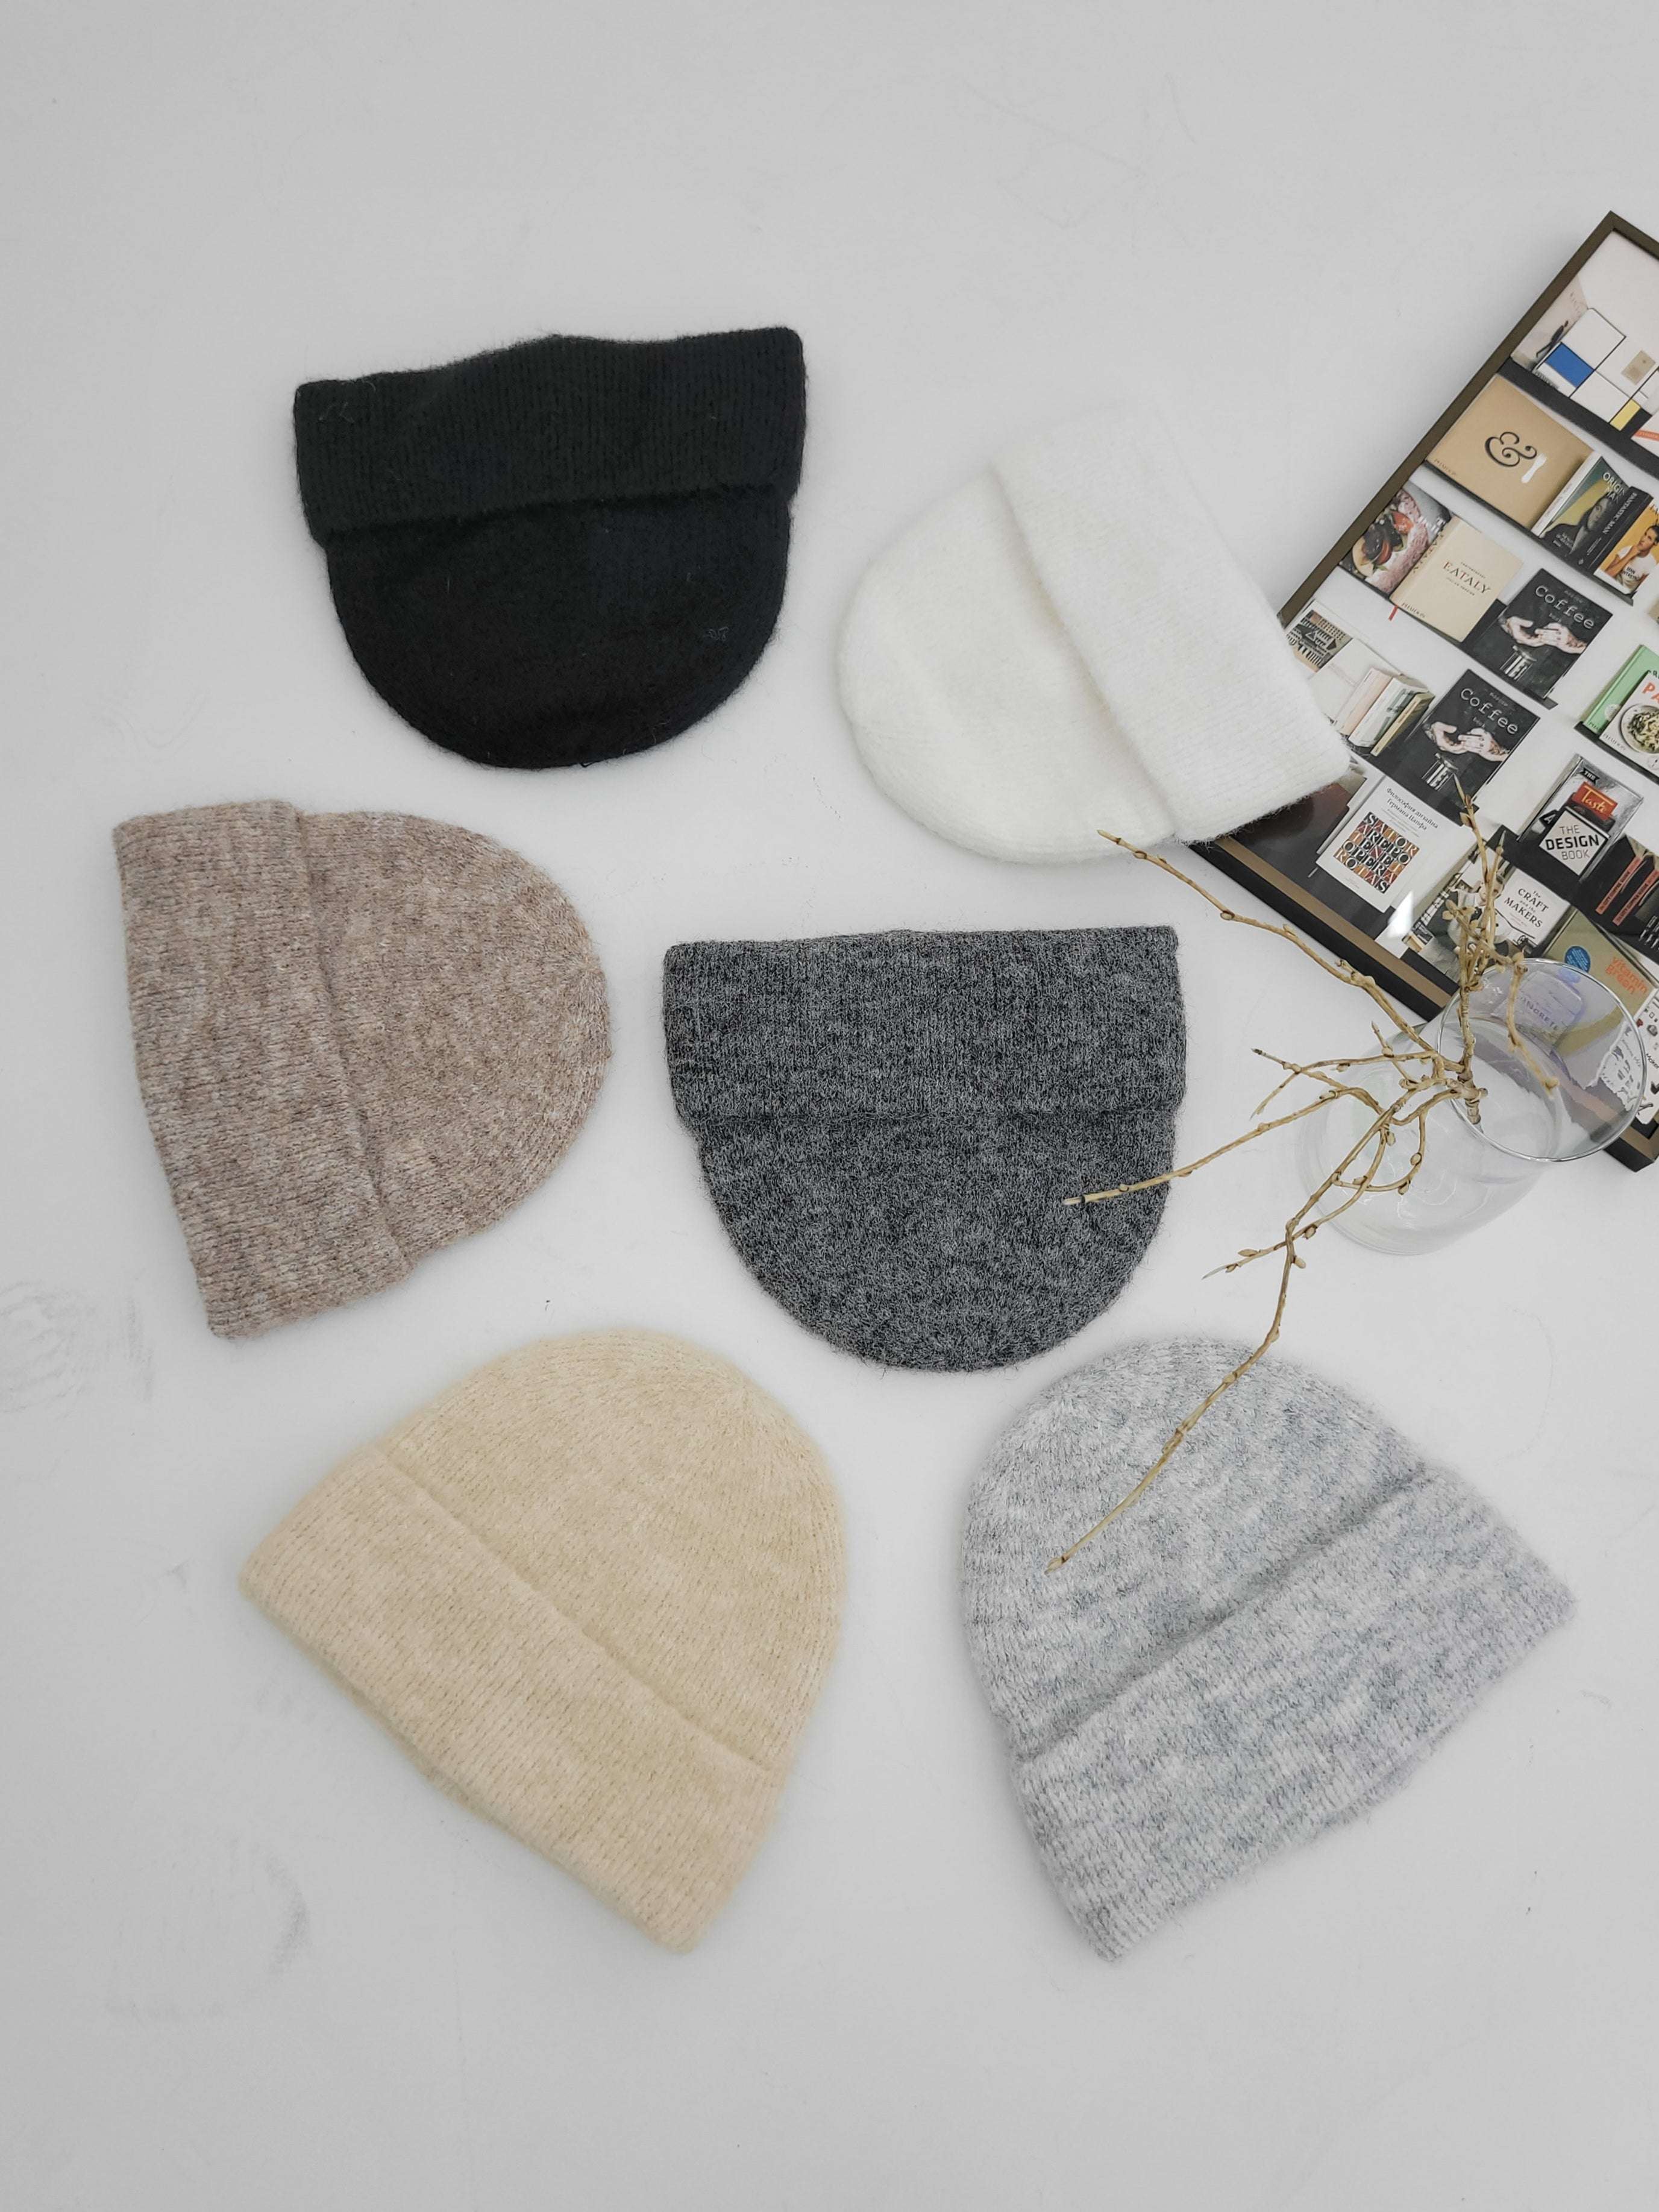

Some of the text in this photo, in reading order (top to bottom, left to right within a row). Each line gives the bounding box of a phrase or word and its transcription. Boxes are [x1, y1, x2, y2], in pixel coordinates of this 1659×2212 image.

[1443, 562, 1491, 593] EATALY
[1535, 585, 1594, 629] Coffee
[1461, 688, 1517, 734] Coffee
[1581, 785, 1614, 812] Taste
[1356, 824, 1411, 864] AREPO
[1366, 814, 1417, 856] SATOR
[1545, 834, 1599, 850] DESIGN
[1559, 825, 1580, 835] THE
[1343, 840, 1396, 883] OPERA
[1350, 831, 1405, 873] TENET
[1561, 849, 1590, 861] BOOK
[1336, 850, 1388, 892] ROTAS
[1504, 897, 1543, 927] MAKERS
[1518, 888, 1549, 911] CRAFT
